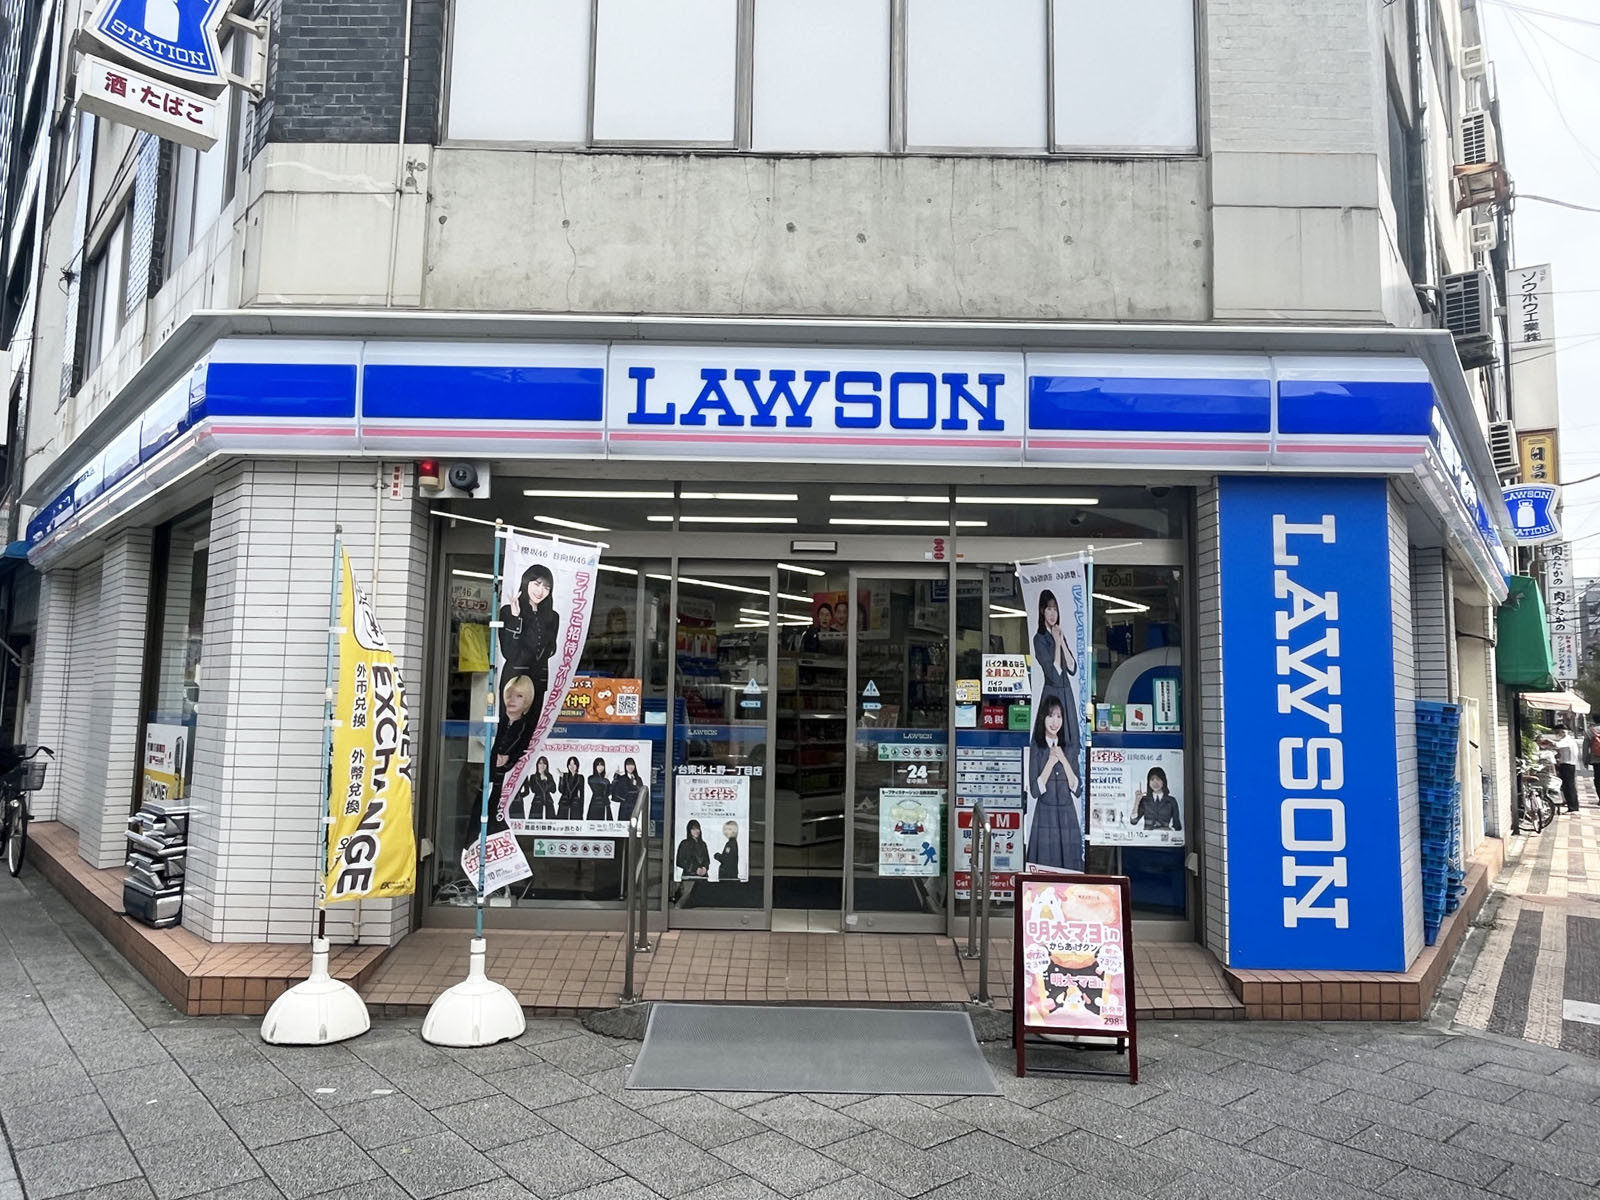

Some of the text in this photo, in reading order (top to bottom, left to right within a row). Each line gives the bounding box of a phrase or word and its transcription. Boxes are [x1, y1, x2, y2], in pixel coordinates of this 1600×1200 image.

[110, 18, 207, 67] STATION
[104, 71, 205, 125] 酒・たばこ
[628, 366, 1005, 432] LAWSON
[1514, 524, 1552, 537] ATION
[984, 714, 1004, 725] 免税
[1272, 513, 1350, 930] LAWSON
[336, 665, 397, 895] EXCHNGE
[907, 764, 928, 779] 24
